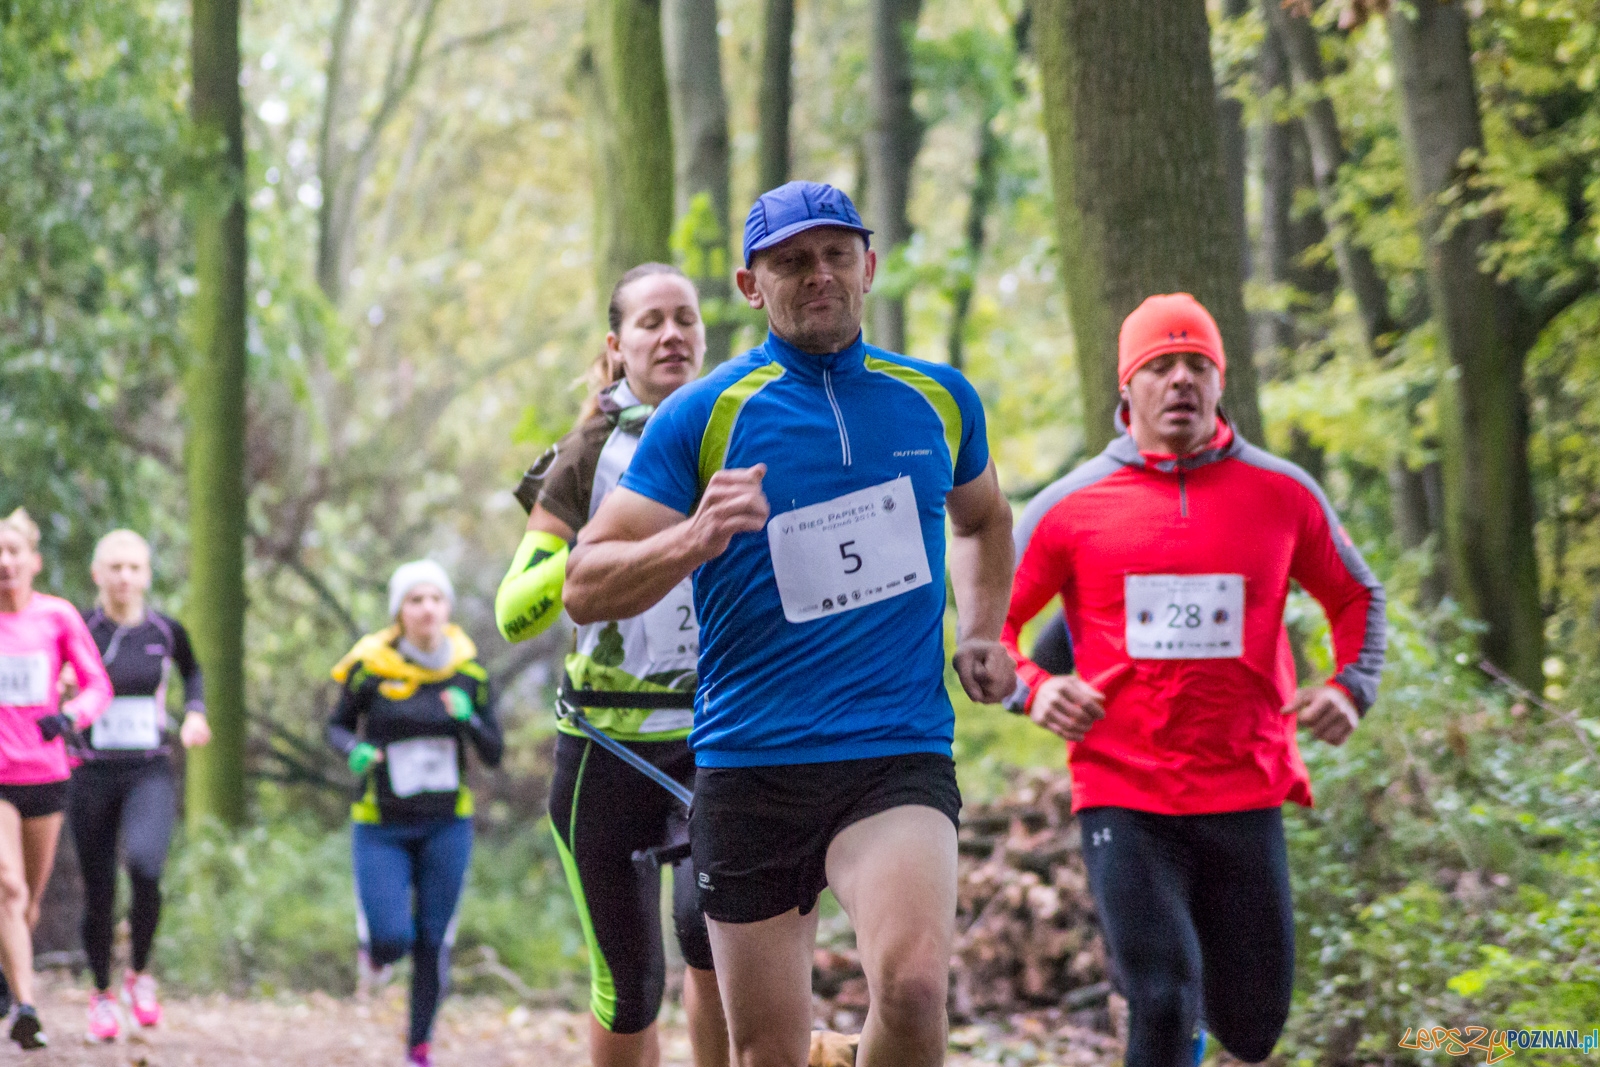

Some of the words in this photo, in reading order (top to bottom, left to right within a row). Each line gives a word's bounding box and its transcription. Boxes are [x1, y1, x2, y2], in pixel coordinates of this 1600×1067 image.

[782, 524, 794, 535] VI
[839, 540, 863, 575] 5
[1166, 603, 1201, 628] 28
